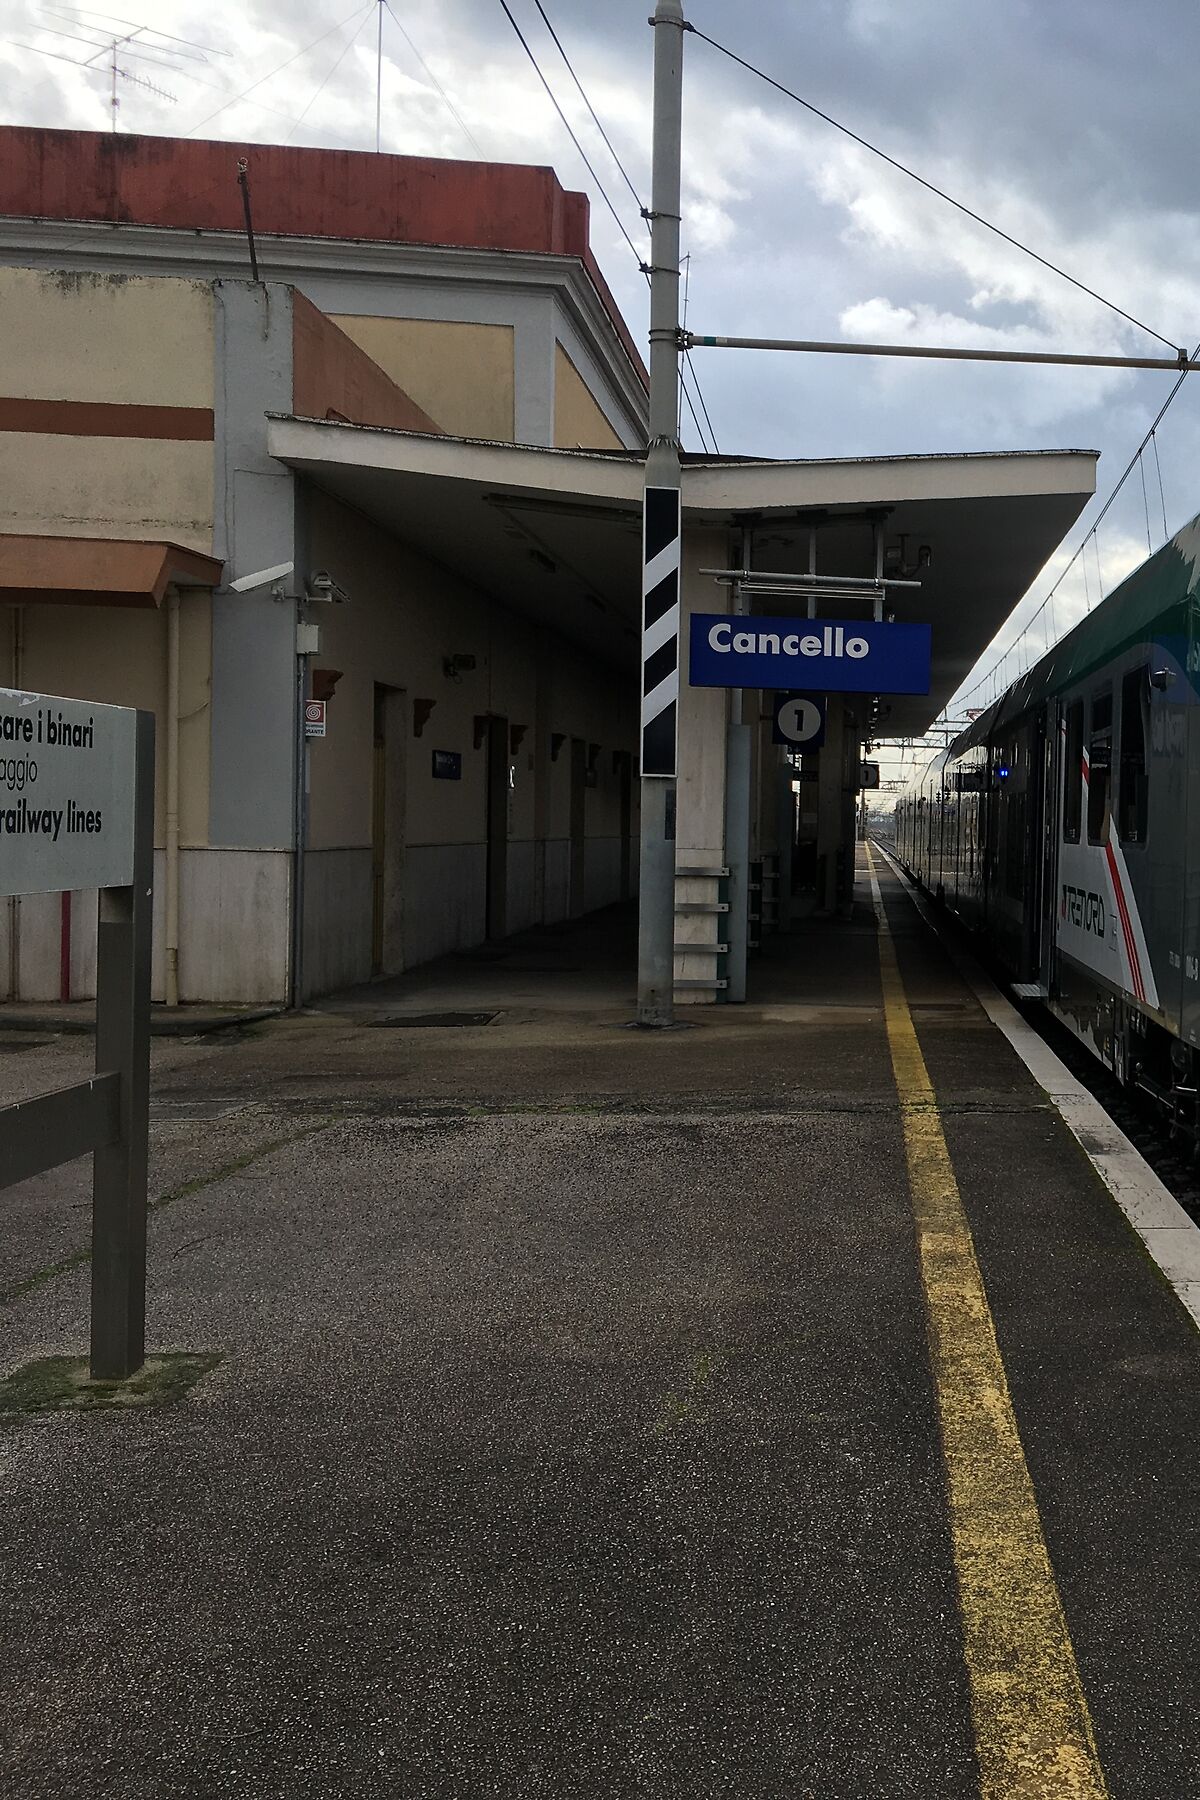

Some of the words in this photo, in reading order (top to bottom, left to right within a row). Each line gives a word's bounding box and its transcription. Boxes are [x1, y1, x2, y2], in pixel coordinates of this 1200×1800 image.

[708, 623, 870, 659] Cancello
[37, 710, 43, 744] i
[47, 710, 94, 749] binari
[794, 709, 804, 732] 1
[0, 798, 63, 842] railway
[66, 799, 102, 833] lines
